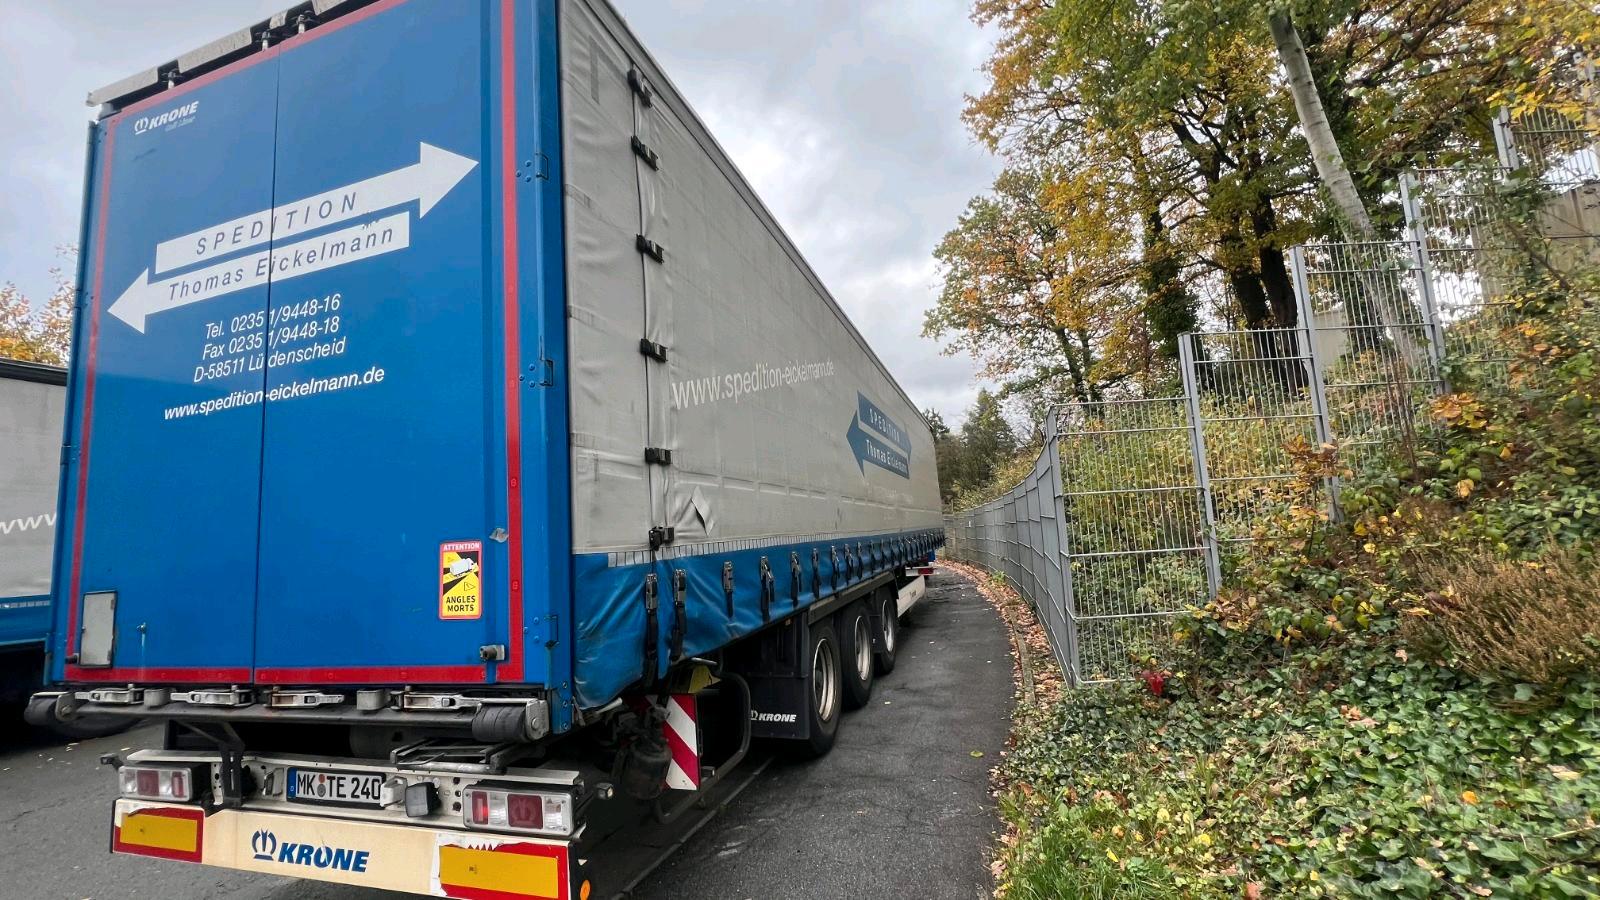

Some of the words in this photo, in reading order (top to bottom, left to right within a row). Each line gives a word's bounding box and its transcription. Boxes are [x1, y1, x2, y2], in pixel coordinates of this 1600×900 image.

[149, 100, 199, 130] KRONE
[196, 192, 356, 255] SPEDITION
[169, 268, 244, 301] Thomas
[255, 227, 393, 277] Eickelmann
[206, 321, 225, 340] Tel.
[202, 343, 225, 360] Fax
[193, 356, 245, 383] D-58511
[164, 366, 385, 421] www.spedition-eickelmann.de
[443, 542, 480, 551] ATTENTION
[446, 595, 476, 604] ANGLES
[447, 604, 475, 612] MORTS
[759, 713, 797, 722] KRONE
[297, 774, 316, 796] MK
[327, 776, 346, 798] TE
[351, 777, 381, 800] 240
[278, 842, 370, 873] KRONE
